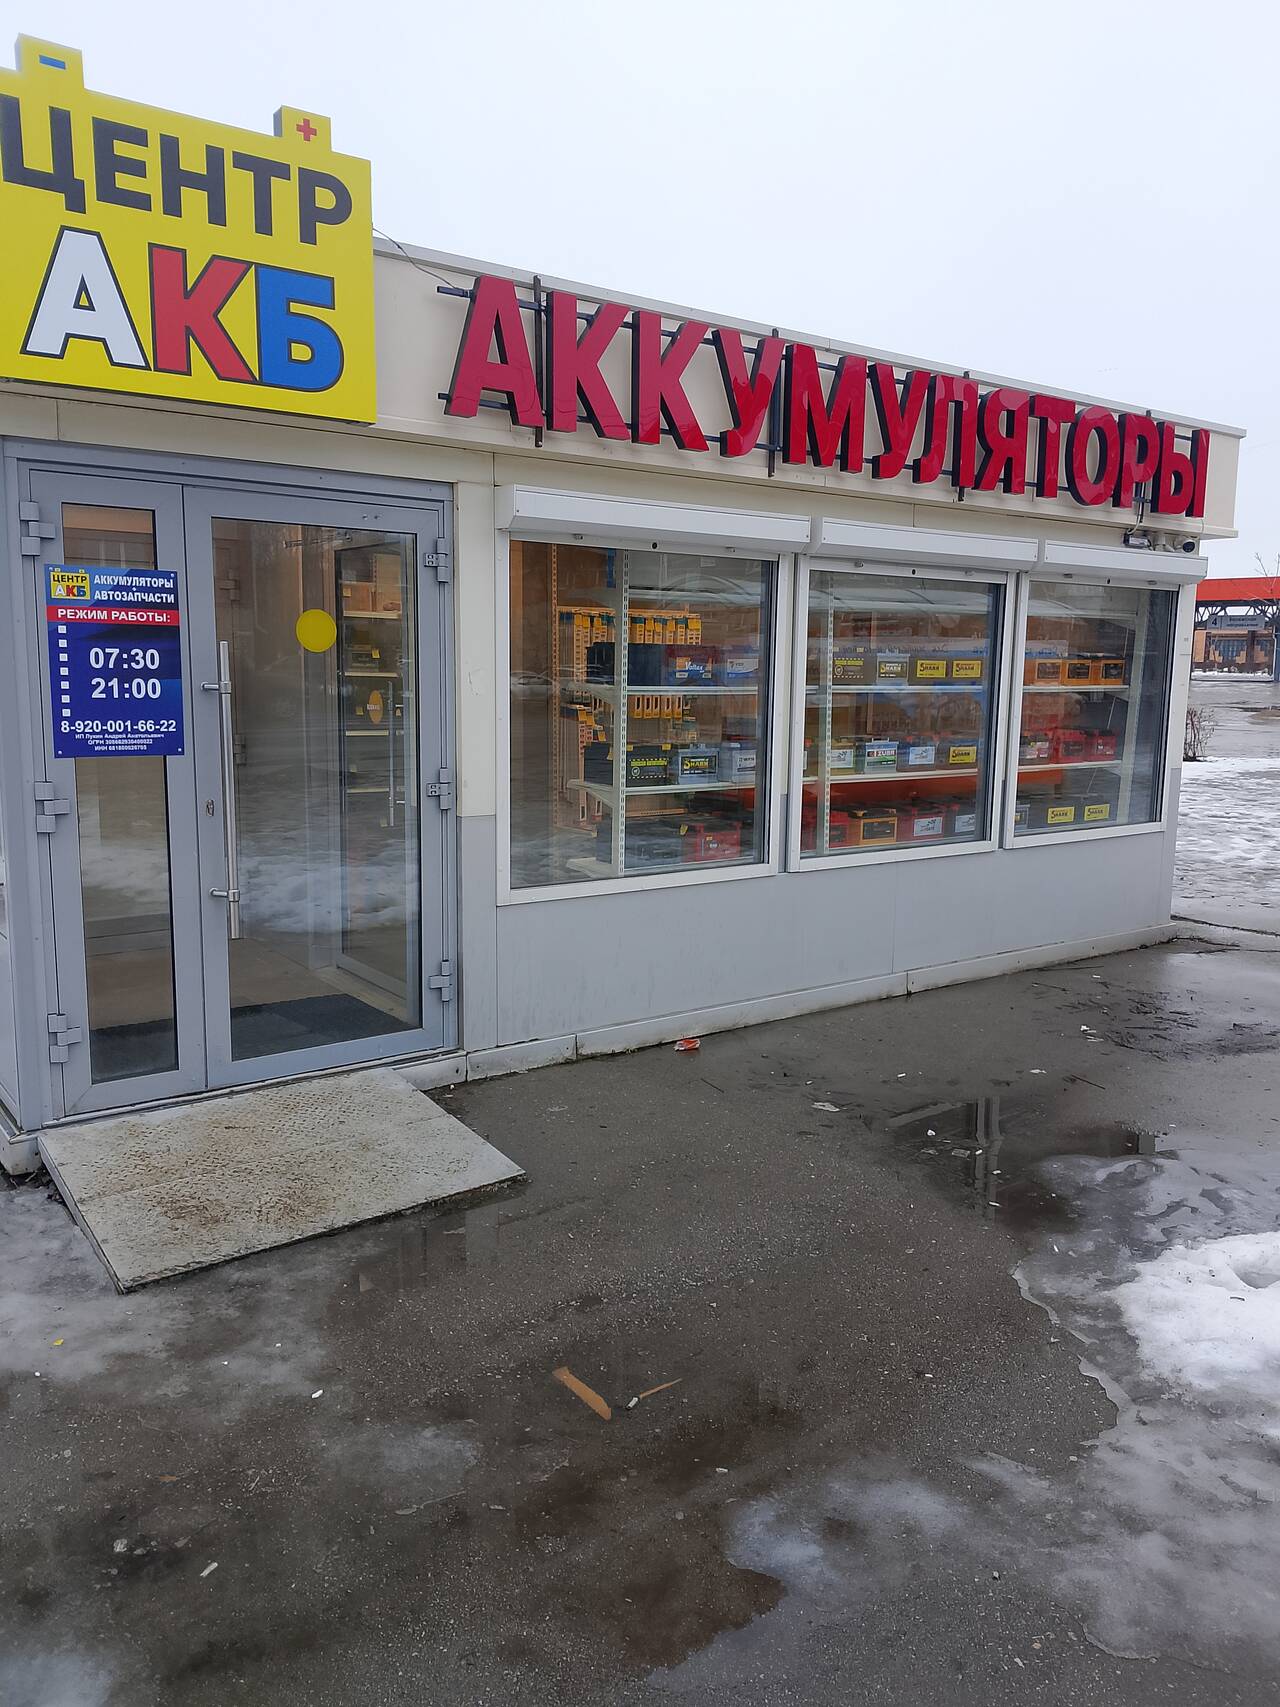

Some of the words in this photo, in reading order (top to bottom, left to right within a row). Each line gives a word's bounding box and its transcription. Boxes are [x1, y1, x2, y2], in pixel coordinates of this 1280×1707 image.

[0, 93, 353, 246] ЦЕНТР
[19, 225, 344, 393] АКБ
[444, 274, 1210, 518] АККУМУЛЯТОРЫ
[52, 574, 87, 583] ЦЕНТР
[94, 574, 174, 589] АККУМУЛЯТОРЫ
[55, 585, 87, 597] АКБ
[94, 590, 174, 603] АВТОЗАПЧАСТИ
[57, 608, 107, 620] РЕЖИМ
[111, 610, 171, 623] РАБОТЫ:
[1211, 617, 1218, 627] 4
[89, 647, 160, 670] 07:30
[91, 677, 161, 699] 21:00
[60, 719, 177, 733] 8-920-001-66-22
